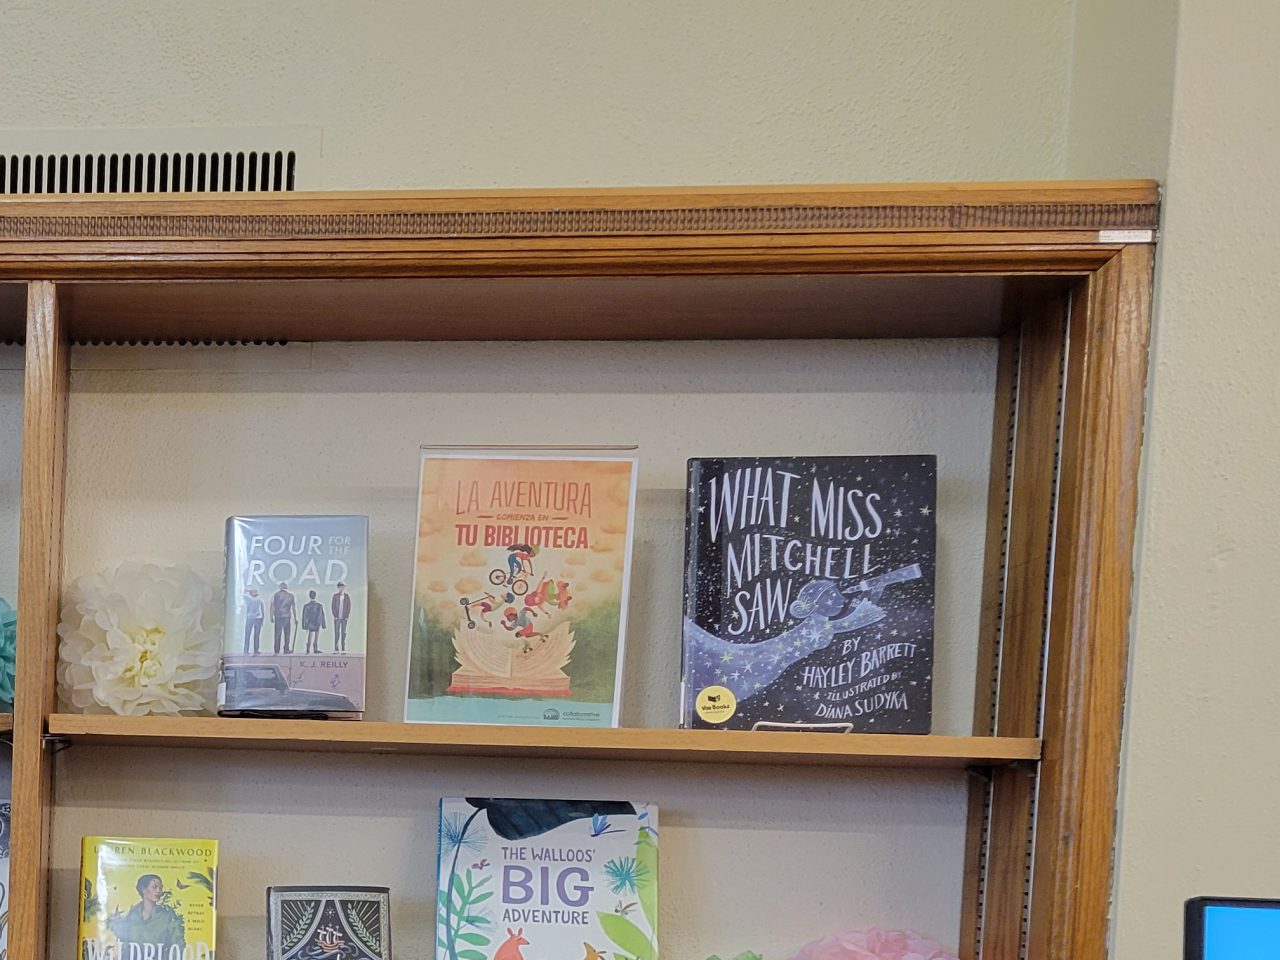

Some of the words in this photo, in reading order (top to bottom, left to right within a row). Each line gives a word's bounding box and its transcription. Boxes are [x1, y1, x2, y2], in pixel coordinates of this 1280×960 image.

[455, 480, 479, 515] LA
[490, 481, 592, 518] AVENTURA
[709, 467, 801, 543] WHAT
[811, 477, 883, 541] MISS
[496, 513, 535, 521] COMIENZA
[250, 535, 322, 555] FOUR
[328, 536, 351, 545] FOR
[455, 524, 478, 546] TU
[483, 525, 589, 549] BIBLIOTECA
[329, 546, 350, 555] THE
[246, 558, 348, 585] ROAD
[726, 533, 881, 598] MITCHELL
[727, 578, 793, 635] SAW
[842, 637, 862, 655] BY
[802, 658, 857, 689] HAYLEY
[859, 642, 917, 679] BARRETT
[827, 674, 891, 701] ILLUSTRATED
[891, 671, 904, 681] BY
[855, 690, 909, 715] SUDYKA
[141, 847, 213, 857] BLACKWOOD
[502, 847, 527, 860] THE
[532, 848, 596, 863] WALLOOS'
[502, 865, 595, 907] BIG
[502, 909, 589, 924] ADVENTURE
